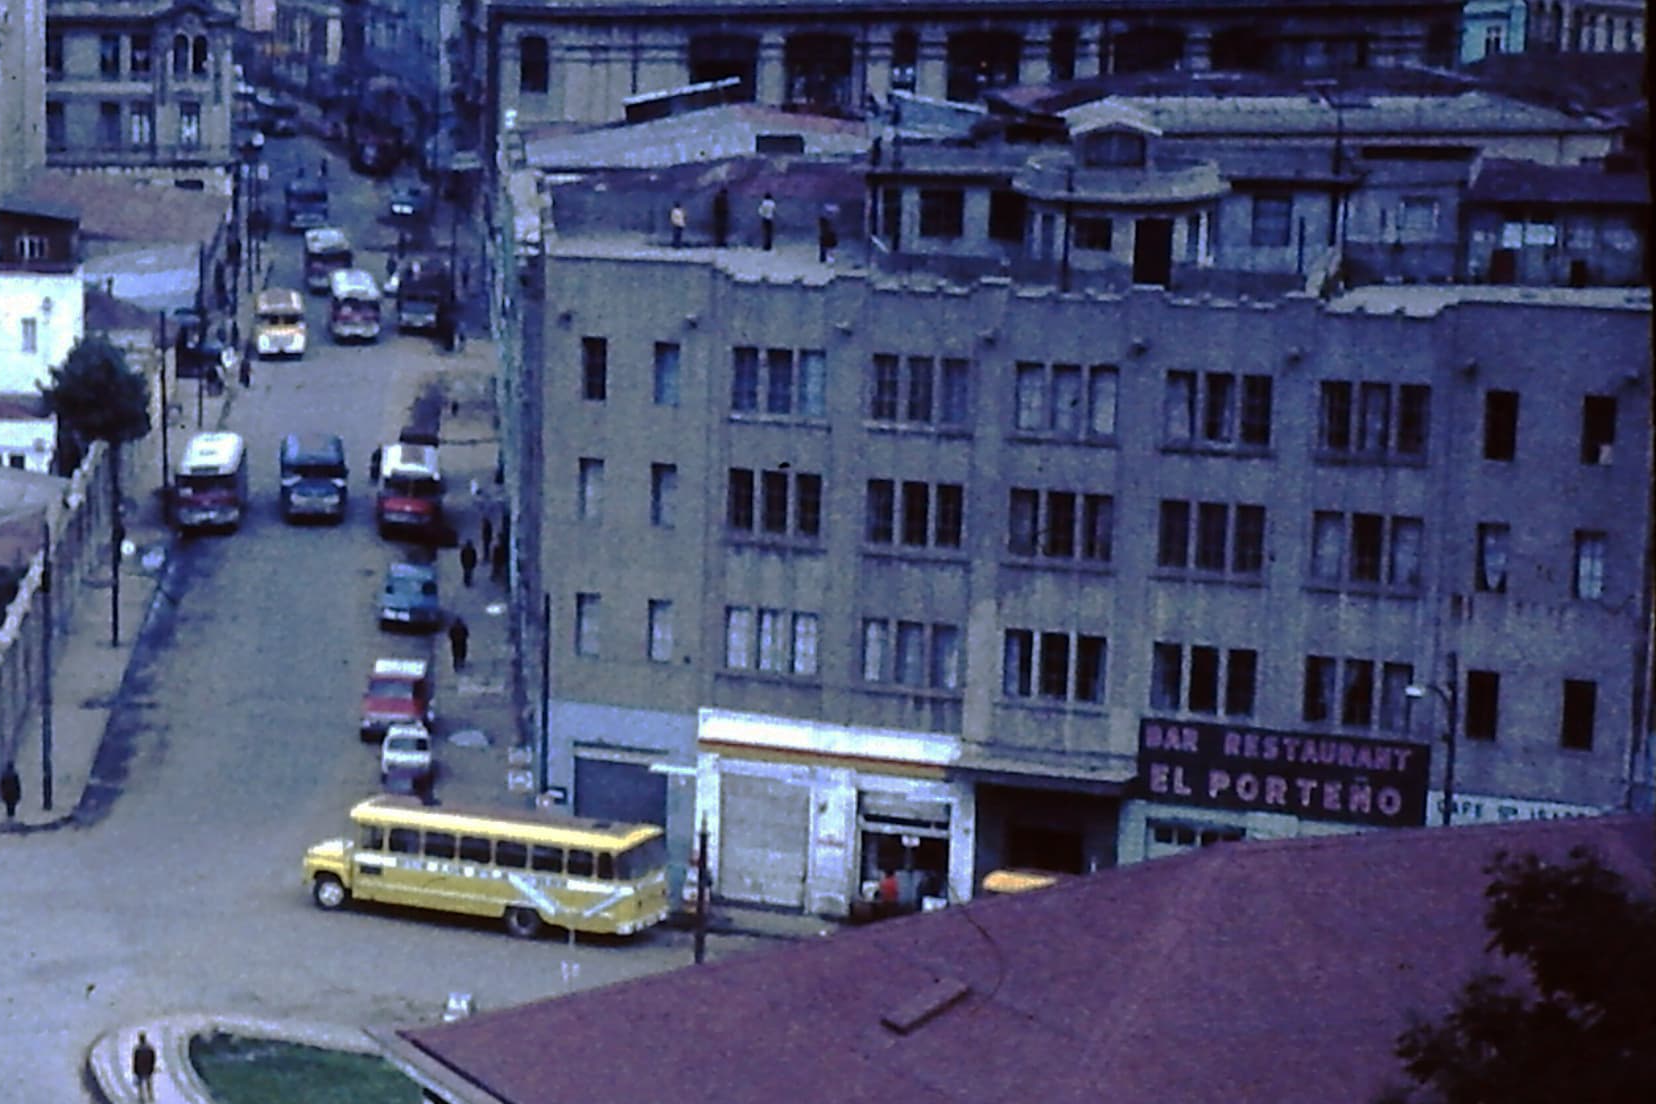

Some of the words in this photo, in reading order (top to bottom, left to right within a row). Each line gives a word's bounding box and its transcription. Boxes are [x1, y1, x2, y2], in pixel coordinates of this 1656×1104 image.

[1145, 723, 1199, 752] BAR
[1224, 731, 1412, 772] RESTAURANT
[1149, 763, 1192, 796] EL
[1208, 769, 1402, 816] PORTEÑO
